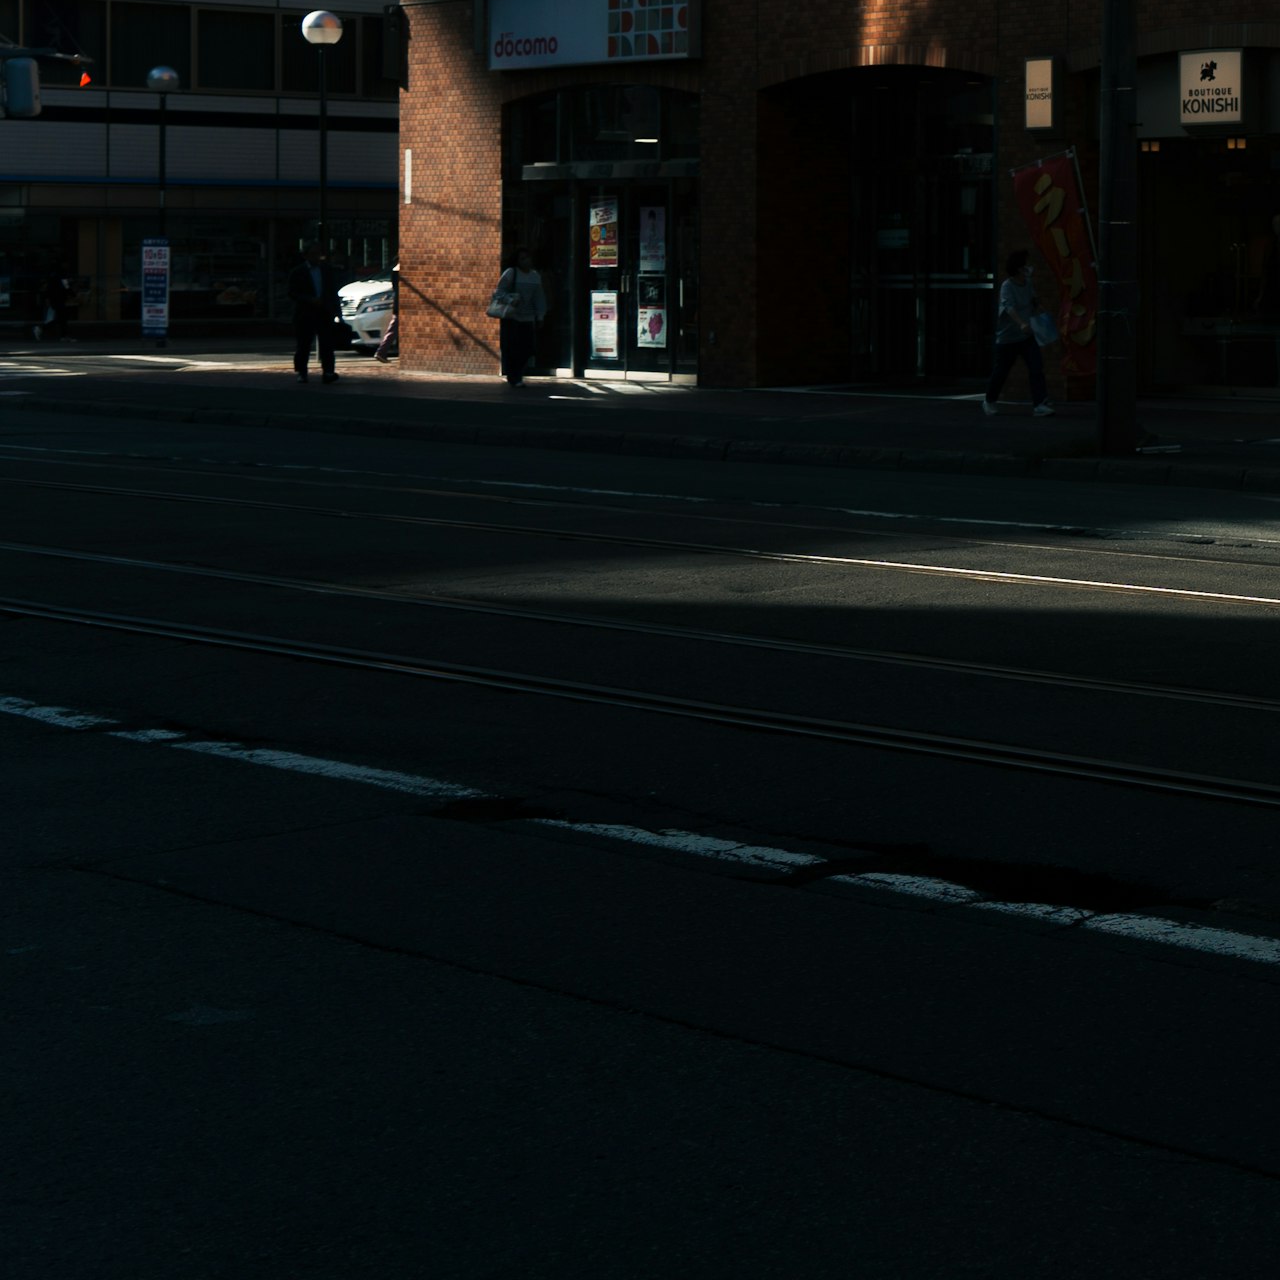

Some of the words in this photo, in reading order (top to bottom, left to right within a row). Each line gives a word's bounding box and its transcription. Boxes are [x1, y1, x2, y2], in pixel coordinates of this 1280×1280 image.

[494, 32, 558, 58] docomo
[1026, 92, 1052, 101] KONISHI
[1188, 87, 1233, 97] BOUTIQUE
[1182, 97, 1239, 114] KONISHI
